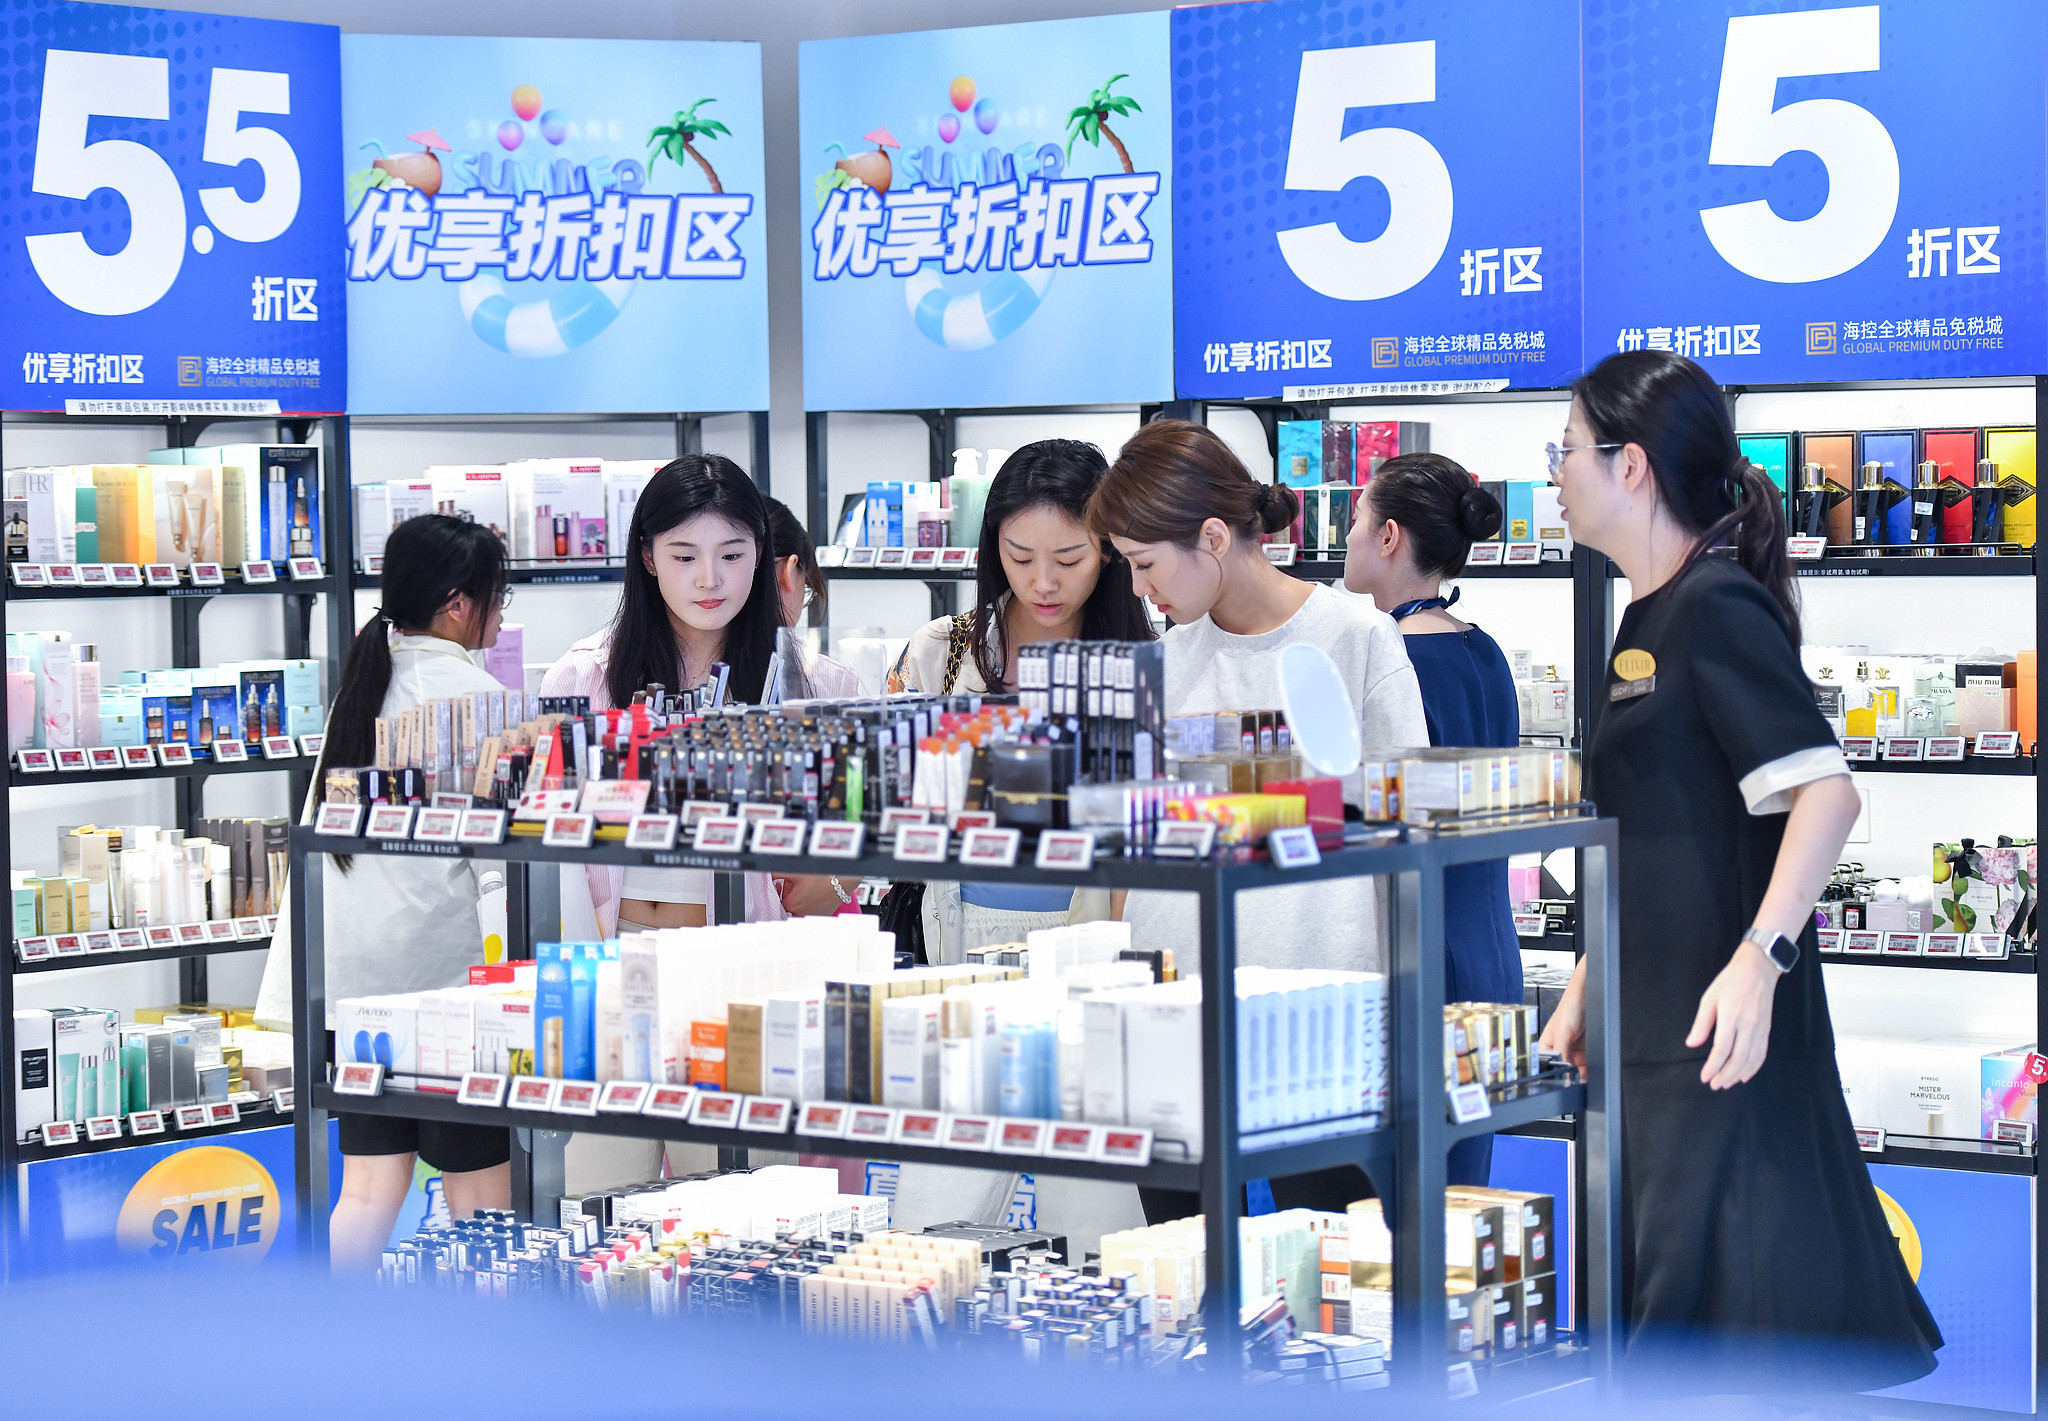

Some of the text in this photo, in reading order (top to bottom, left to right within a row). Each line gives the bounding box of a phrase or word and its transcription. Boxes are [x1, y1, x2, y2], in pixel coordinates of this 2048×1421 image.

[1700, 5, 1900, 284] 5
[24, 48, 301, 316] 5.5
[1277, 40, 1454, 301] 5
[348, 190, 752, 280] 优享折扣区
[815, 173, 1159, 280] 优享折扣区
[1907, 226, 2000, 278] 折区
[1460, 246, 1543, 297] 折区
[251, 275, 319, 321] 折区
[1404, 331, 1546, 354] 海控全球精品免税城
[1843, 316, 2003, 341] 海控全球精品免税城
[1203, 339, 1333, 373] 优享折扣区
[1404, 351, 1546, 367] GLOBAL PREMIUM DUTY FREE
[1843, 337, 2003, 354] GLOBAL PREMIUM DUTY FREE
[22, 352, 144, 384] 优享折扣区
[205, 356, 320, 375] 海控全球精品免税城
[30, 475, 48, 491] HR
[1620, 659, 1651, 672] ELIXIR
[355, 1007, 391, 1017] SHISEIDO
[1910, 1092, 1950, 1100] MARVELOUS
[1991, 1077, 2029, 1089] incanto
[149, 1195, 264, 1257] SALE
